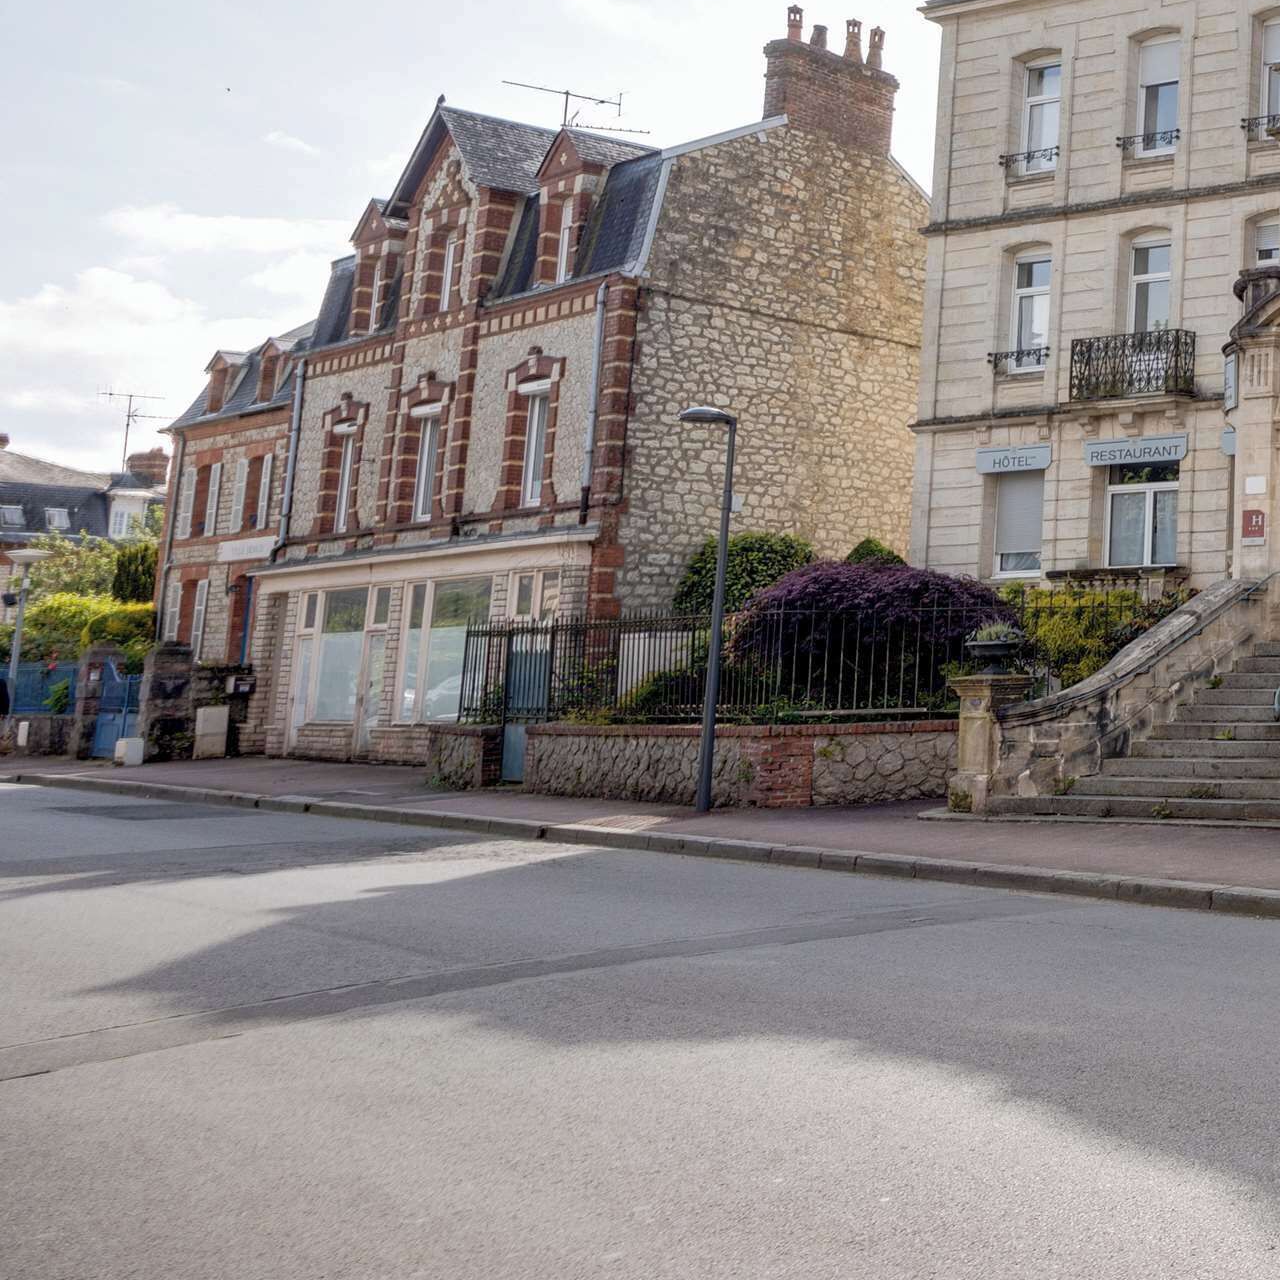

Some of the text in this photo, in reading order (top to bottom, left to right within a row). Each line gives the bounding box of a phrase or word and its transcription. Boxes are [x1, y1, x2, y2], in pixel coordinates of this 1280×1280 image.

[1090, 445, 1182, 462] RESTAURANT
[993, 455, 1032, 469] HÔTEL
[1252, 514, 1263, 526] H
